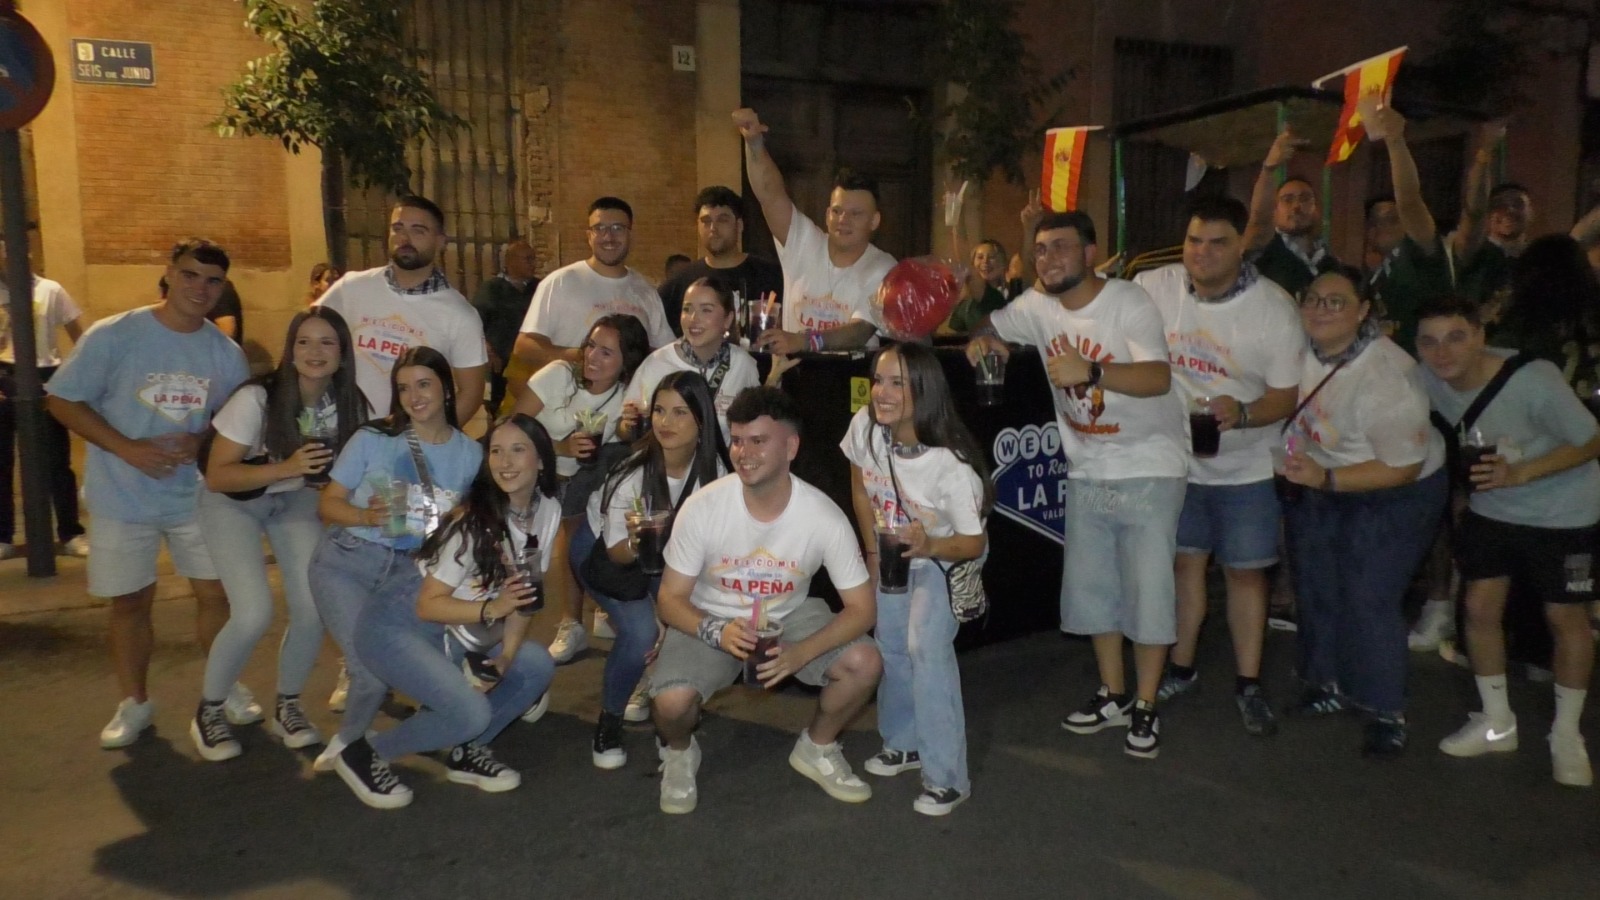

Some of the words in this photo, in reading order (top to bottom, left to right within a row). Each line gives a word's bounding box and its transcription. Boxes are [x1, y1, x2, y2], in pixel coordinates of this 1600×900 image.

[101, 46, 136, 59] CALLE
[678, 51, 690, 65] 12
[78, 63, 102, 78] SEIS
[121, 66, 151, 80] JUNIO
[800, 312, 814, 327] LA
[357, 334, 376, 350] LA
[1168, 352, 1185, 367] LA
[154, 394, 167, 403] LA
[1027, 463, 1044, 479] TO
[1018, 484, 1048, 511] LA
[721, 556, 796, 569] WELCOME
[721, 578, 742, 592] LA
[748, 579, 794, 594] PEÑA
